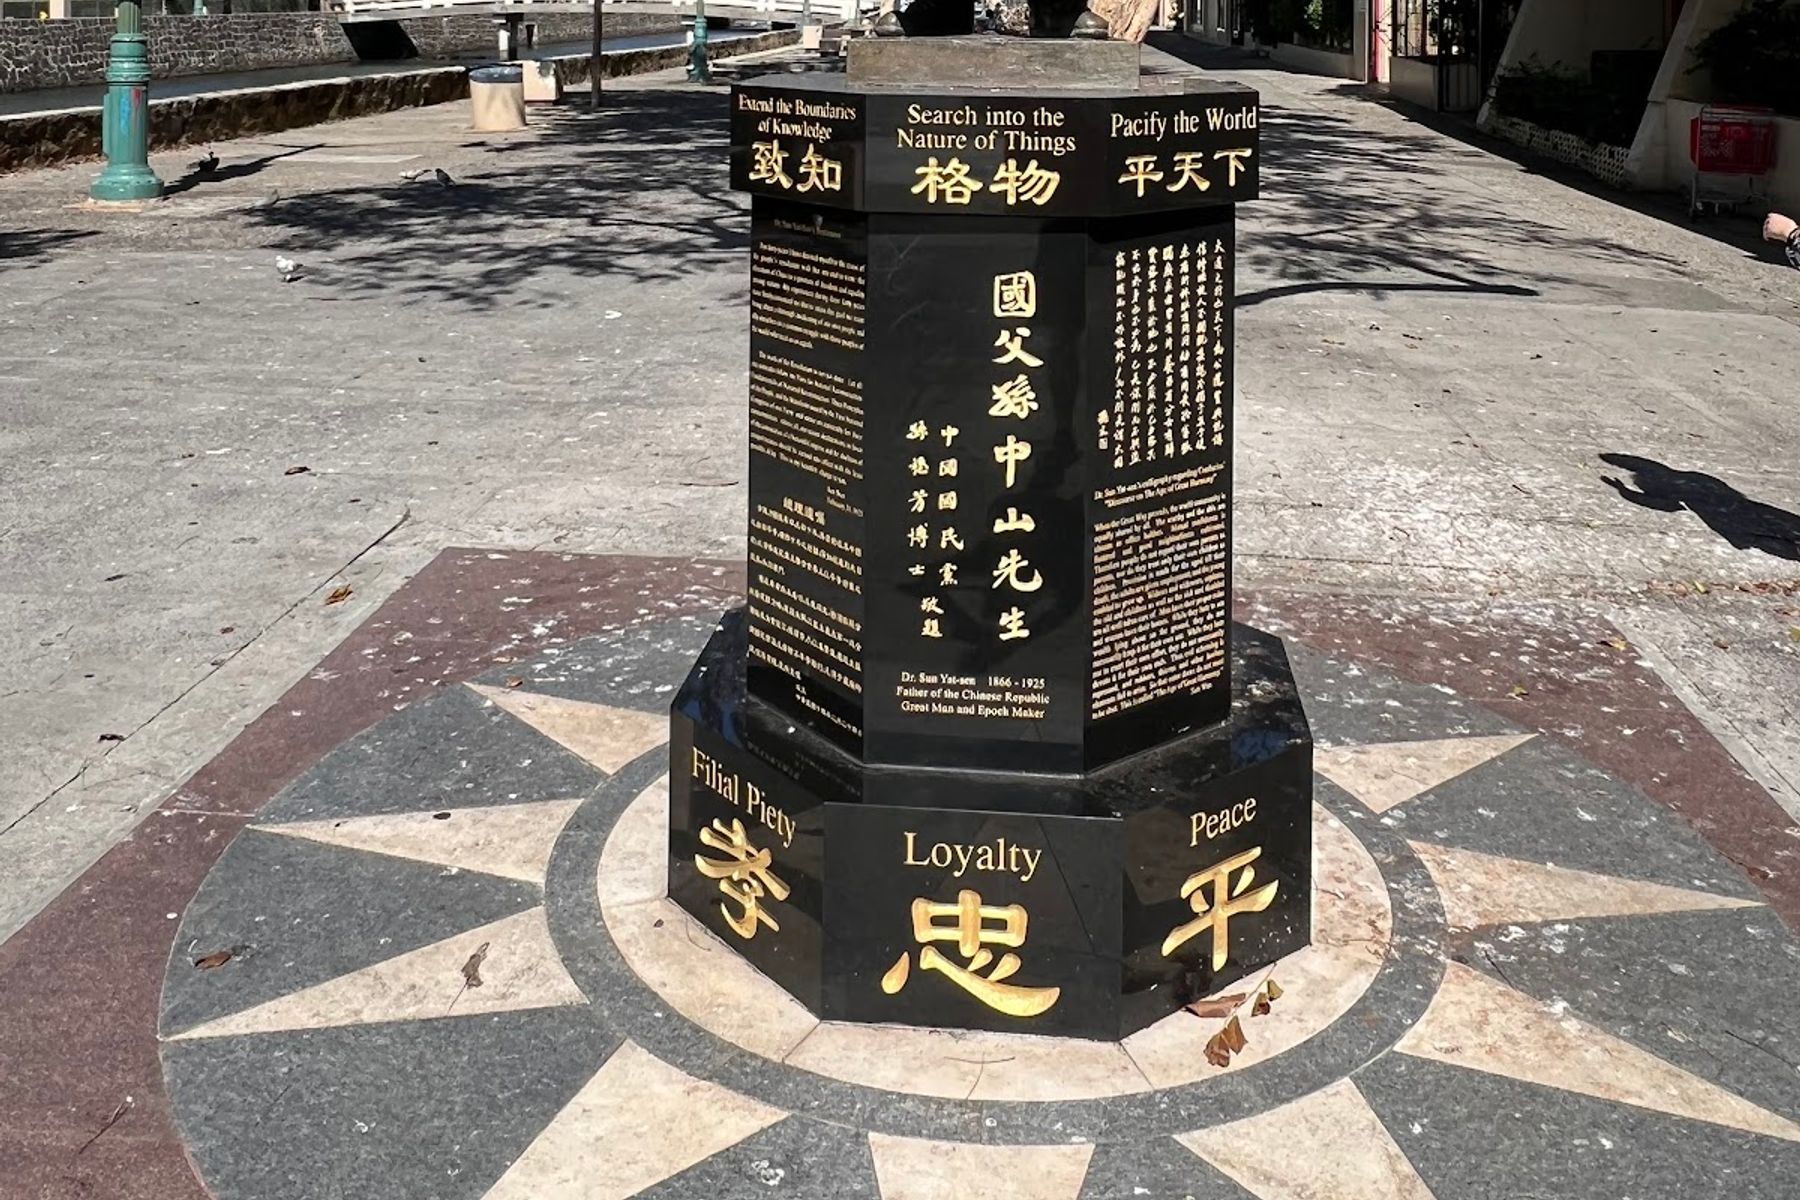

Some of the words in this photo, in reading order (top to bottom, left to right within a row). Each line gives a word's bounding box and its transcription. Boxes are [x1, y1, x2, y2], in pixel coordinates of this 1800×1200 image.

[739, 93, 774, 113] Extend
[776, 97, 793, 115] the
[795, 99, 857, 120] Boundaries
[758, 117, 772, 133] of
[773, 118, 832, 144] Knowledge
[907, 103, 978, 126] Search
[986, 104, 1025, 126] into
[1033, 106, 1065, 127] the
[1110, 110, 1168, 142] Pacify
[1174, 110, 1200, 134] the
[1205, 106, 1258, 131] World
[749, 138, 842, 193] 致知
[896, 128, 968, 150] Nature
[974, 129, 998, 150] of
[1004, 130, 1077, 157] Things
[910, 156, 1061, 206] 格物
[1117, 147, 1254, 198] 平天下
[989, 270, 1044, 641] 國父孫中山先生
[896, 686, 929, 698] Father
[930, 686, 942, 698] of
[943, 688, 960, 699] the
[961, 689, 1002, 702] Chinese
[1004, 691, 1050, 705] Republic
[901, 672, 916, 683] Dr.
[919, 672, 938, 684] Sun
[940, 673, 976, 686] Yat-sen
[988, 676, 1012, 687] 1866
[1021, 678, 1046, 690] 1925
[901, 700, 930, 712] Great
[931, 702, 954, 714] Man
[956, 704, 975, 715] and
[978, 705, 1009, 718] Epoch
[1012, 707, 1046, 719] Maker
[692, 746, 739, 806] Filial
[746, 781, 797, 849] Piety
[1189, 797, 1257, 848] Peace
[694, 817, 792, 940] 孝
[903, 831, 1043, 882] Loyalty
[1161, 846, 1279, 972] 平
[881, 889, 1061, 1017] 忠
